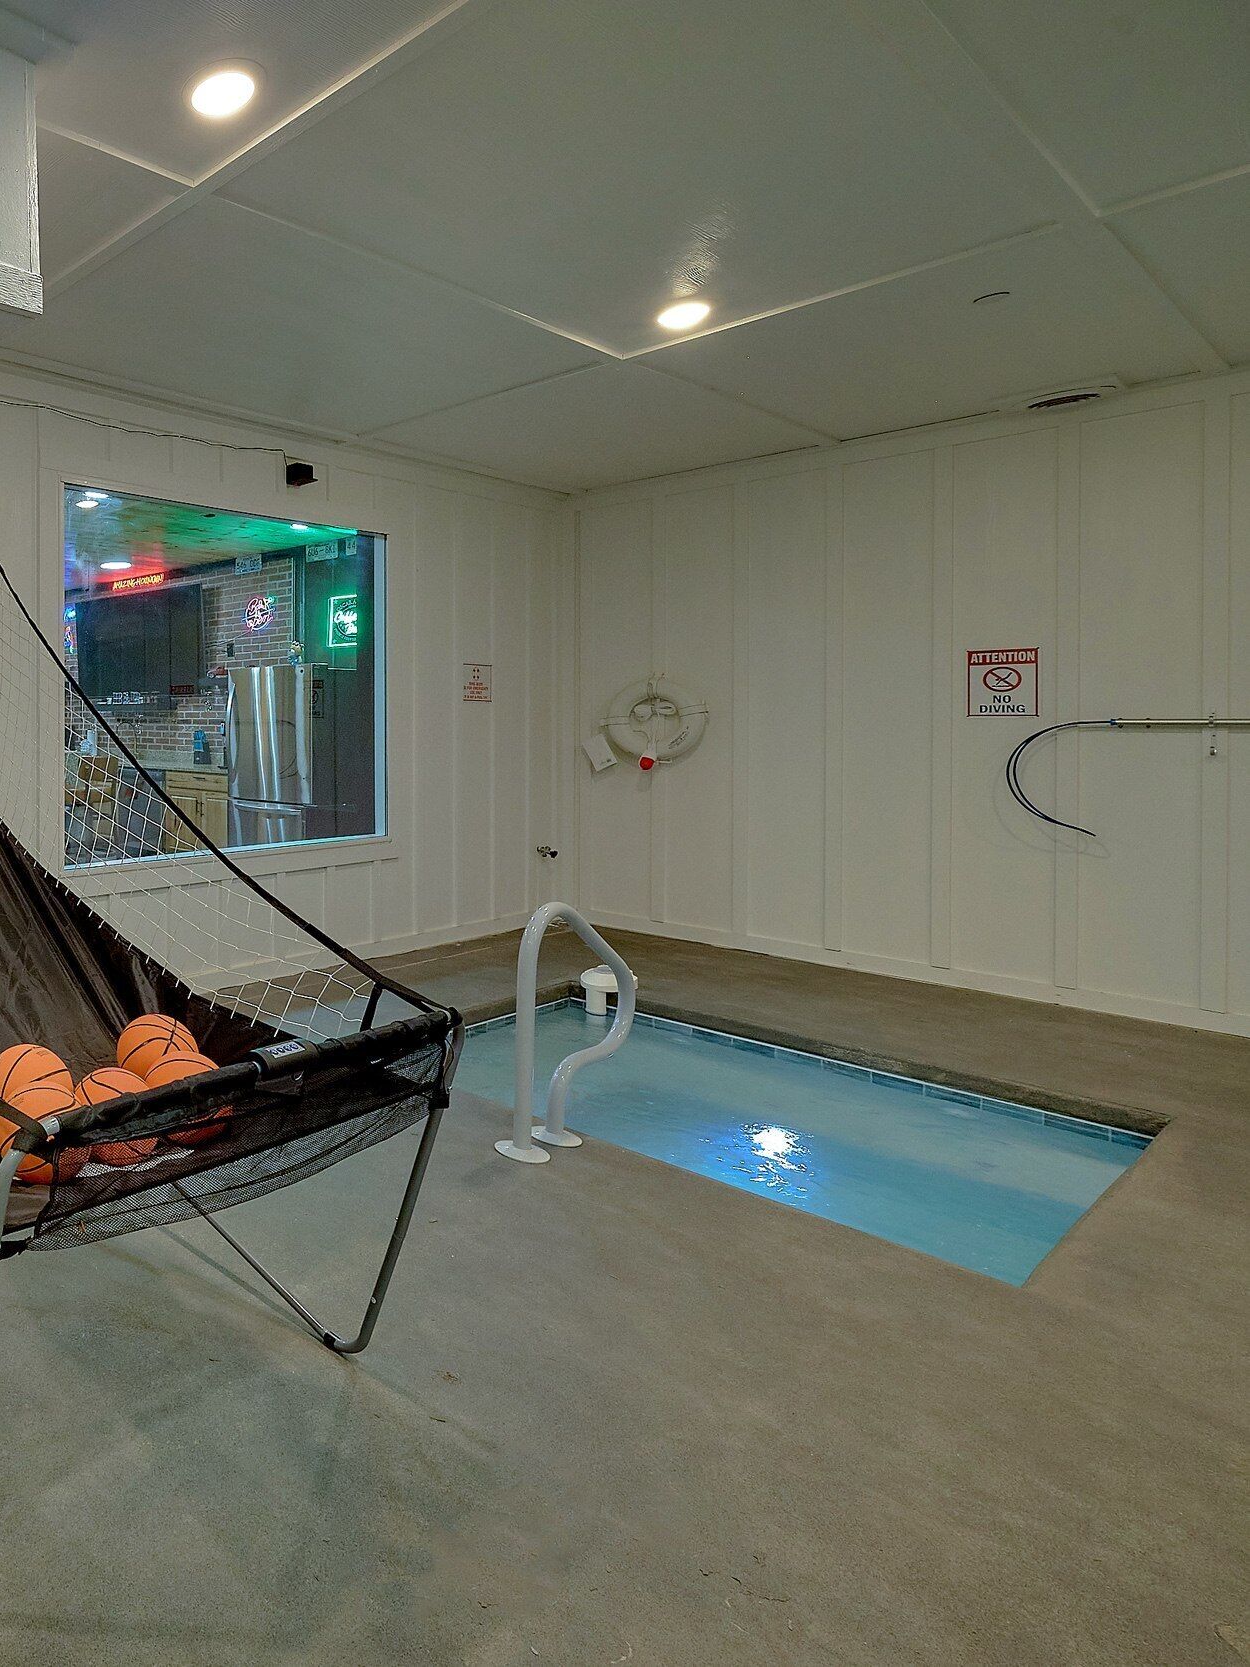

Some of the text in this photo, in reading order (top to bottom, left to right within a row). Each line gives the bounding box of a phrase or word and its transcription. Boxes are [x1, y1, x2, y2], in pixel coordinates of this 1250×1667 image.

[970, 650, 1036, 664] ATTENTION
[992, 694, 1012, 704] NO
[979, 704, 1026, 714] DIVING
